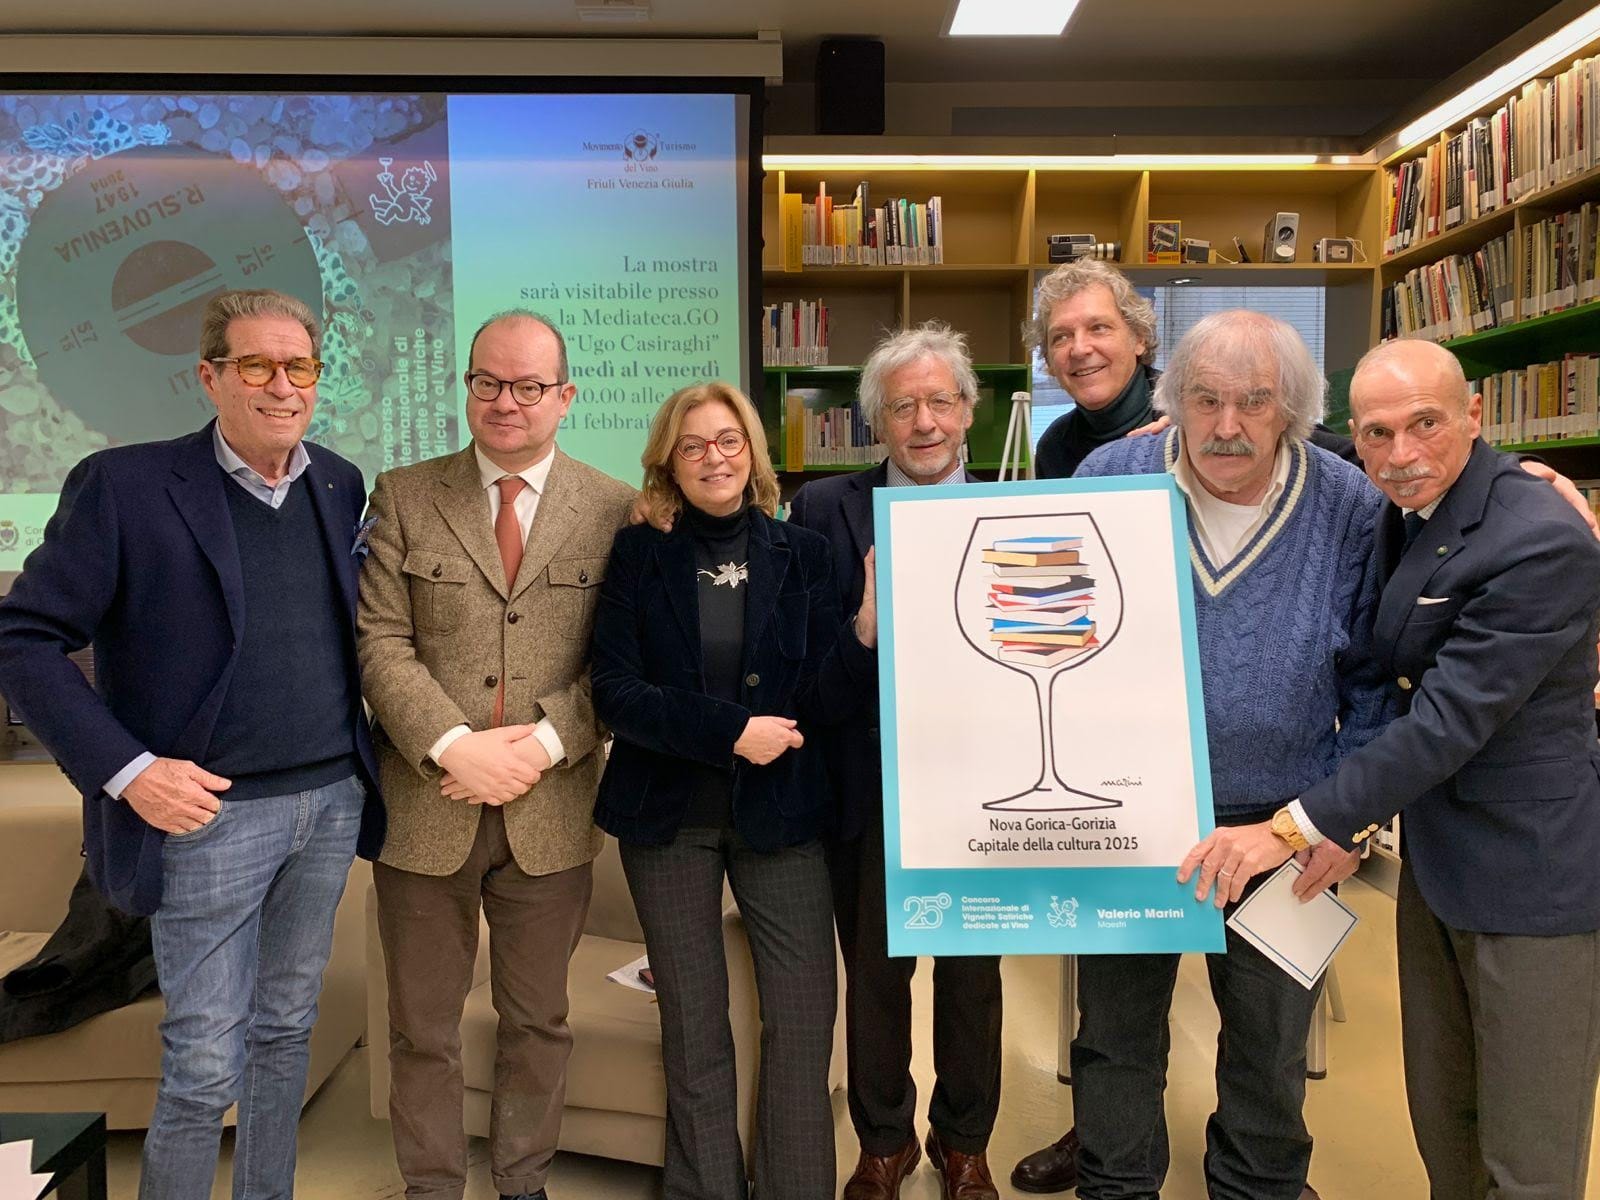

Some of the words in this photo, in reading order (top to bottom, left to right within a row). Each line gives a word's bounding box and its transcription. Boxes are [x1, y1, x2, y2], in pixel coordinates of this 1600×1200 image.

[624, 162, 637, 173] del
[640, 162, 659, 173] Vino
[587, 178, 616, 190] Friuli
[619, 178, 659, 190] Venezia
[661, 177, 695, 190] Giulia
[95, 182, 140, 215] 1947
[623, 255, 647, 273] La
[652, 257, 719, 273] mostra
[520, 282, 560, 300] sarà
[564, 281, 653, 300] visitabile
[658, 286, 719, 303] presso
[559, 308, 576, 326] la
[582, 307, 720, 326] Mediateca.GO
[394, 336, 408, 352] di
[413, 327, 428, 403] Satiriche
[431, 338, 445, 376] Vino
[571, 359, 615, 378] nedì
[620, 360, 639, 378] al
[644, 359, 721, 378] venerdì
[432, 380, 446, 396] al
[631, 386, 665, 404] alle
[396, 357, 412, 467] ternazionale
[433, 401, 448, 457] dicate
[584, 412, 650, 431] febbrai
[415, 407, 433, 461] gnette
[989, 817, 1022, 832] Nova
[1025, 816, 1117, 832] Gorica-Gorizia
[967, 837, 1020, 856] Capitale
[1022, 836, 1054, 851] della
[1056, 836, 1102, 851] cultura
[1103, 836, 1139, 851] 2025
[961, 895, 1001, 904] Concorso
[961, 904, 1020, 913] Internazionale
[1020, 904, 1030, 912] di
[961, 912, 997, 922] Vignette
[997, 912, 1035, 921] Satiriche
[1096, 909, 1142, 919] Valerio
[1145, 908, 1185, 919] Marini
[962, 921, 1000, 930] dedicate
[1000, 921, 1011, 930] al
[1011, 921, 1030, 930] Vino
[1097, 920, 1127, 929] Maestri
